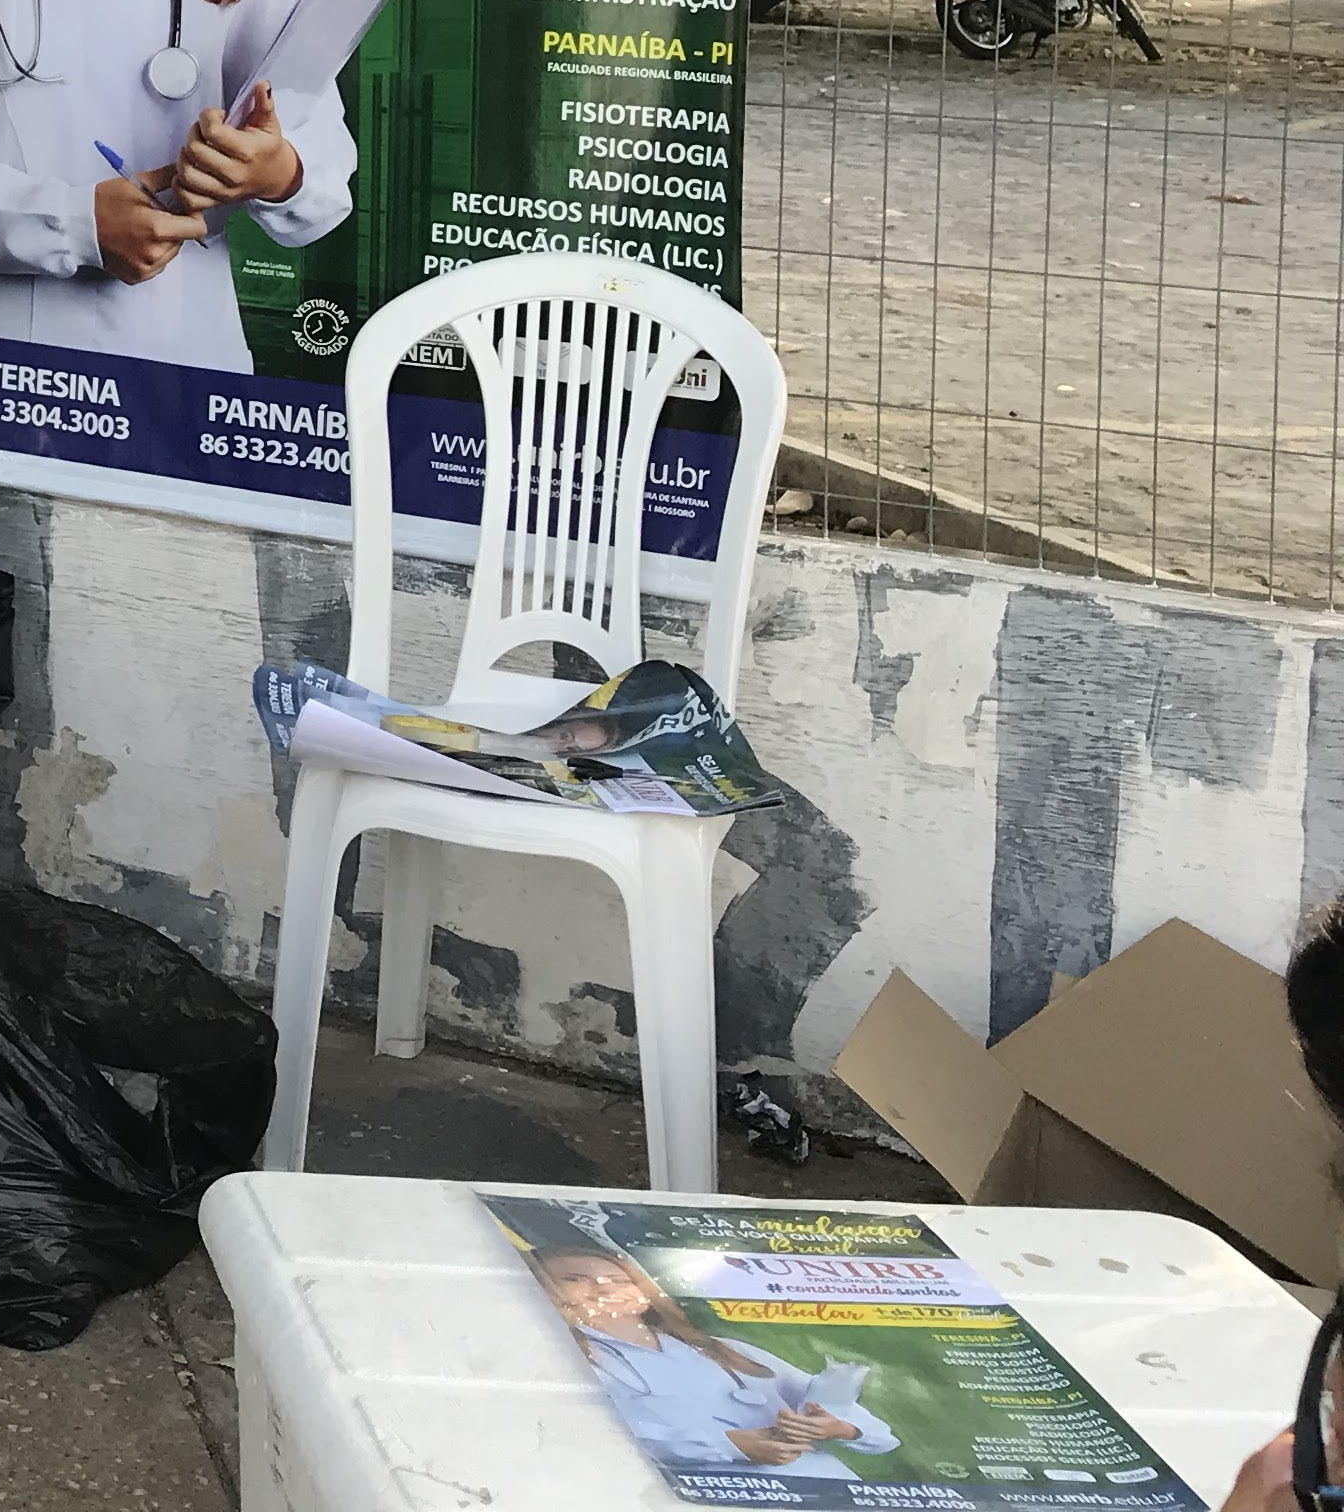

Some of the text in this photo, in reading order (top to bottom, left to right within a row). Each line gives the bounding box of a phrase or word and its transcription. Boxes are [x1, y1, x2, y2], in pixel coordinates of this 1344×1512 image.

[543, 31, 686, 62] PARNAÍBA
[712, 42, 733, 66] PI
[547, 62, 733, 85] FACULDADE REGIONAL BRASILEIRA
[561, 101, 731, 135] FISIOTERAPIA
[578, 136, 729, 169] PSICOLOGIA
[569, 169, 727, 203] RADIOLOGIA
[452, 192, 725, 237] RECURSOS HUMANOS
[431, 223, 724, 276] EDUCAÇÃO FÍSICA (LIC.)
[293, 299, 349, 324] VESTIBULAR
[292, 330, 348, 355] AGENDADO
[0, 400, 130, 441] 3304.3003
[208, 395, 349, 440] PARNAÍB
[200, 434, 229, 457] 86
[669, 1213, 734, 1229] SEJA
[739, 1219, 756, 1230] A
[699, 1228, 736, 1238] QUE
[748, 1257, 945, 1280] UNIRB
[719, 1299, 865, 1322] Vestibular
[912, 1306, 953, 1318] 170
[944, 1347, 1041, 1359] ENFERMAGEM
[1001, 1356, 1049, 1368] SOCIAL
[958, 1379, 1071, 1392] ADMINISTRAÇÃO
[983, 1371, 1064, 1384] PEDAGOGIA
[1008, 1408, 1099, 1422] FISIOTERAPIA
[1024, 1417, 1108, 1430] PSICOLOGIA
[974, 1434, 1124, 1449] RECURSOS HUMANOS
[1029, 1426, 1116, 1439] RADIOLOGIA
[975, 1451, 1142, 1466] PROCESSOS GERENCIAIS
[678, 1474, 789, 1491] TERESINA
[847, 1484, 964, 1500] PARNAÍBA
